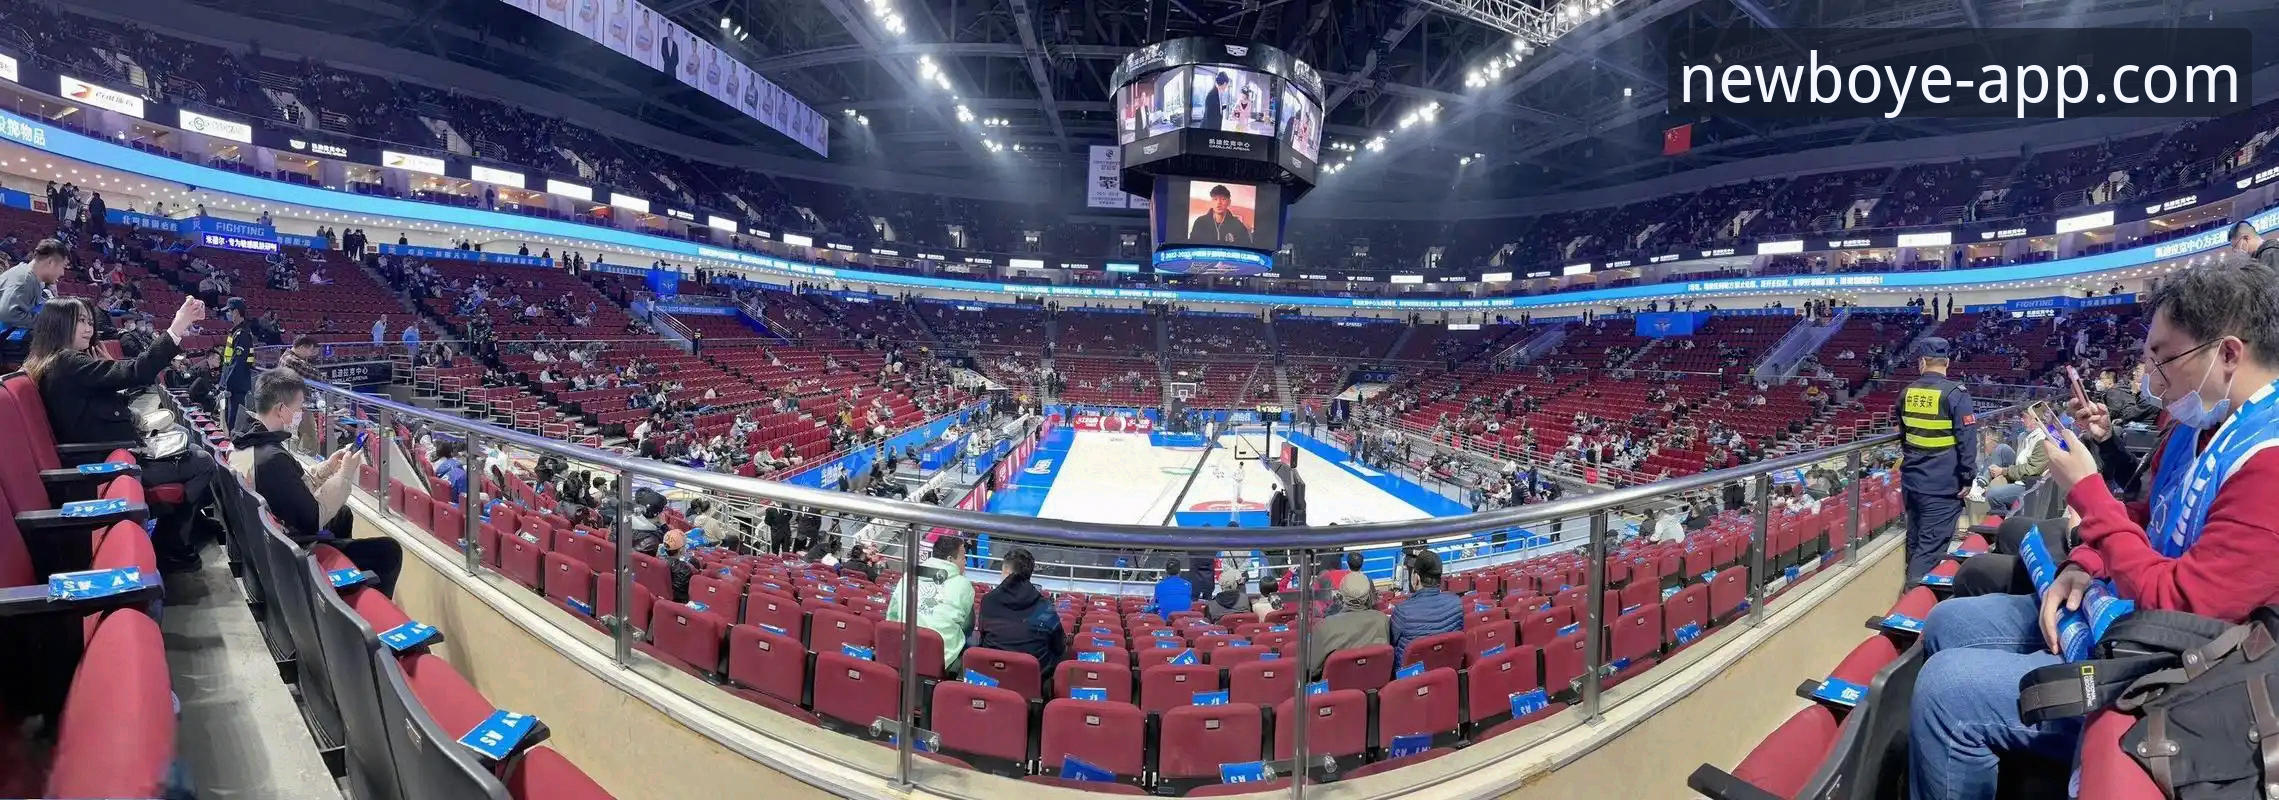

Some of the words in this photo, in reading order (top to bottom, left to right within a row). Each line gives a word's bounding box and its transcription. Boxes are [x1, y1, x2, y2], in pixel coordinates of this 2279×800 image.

[216, 221, 265, 237] FIGHTING
[2015, 300, 2054, 308] FIGHTING
[2083, 675, 2093, 707] GEOGRAPHIC
[2089, 675, 2097, 700] NATIONAL
